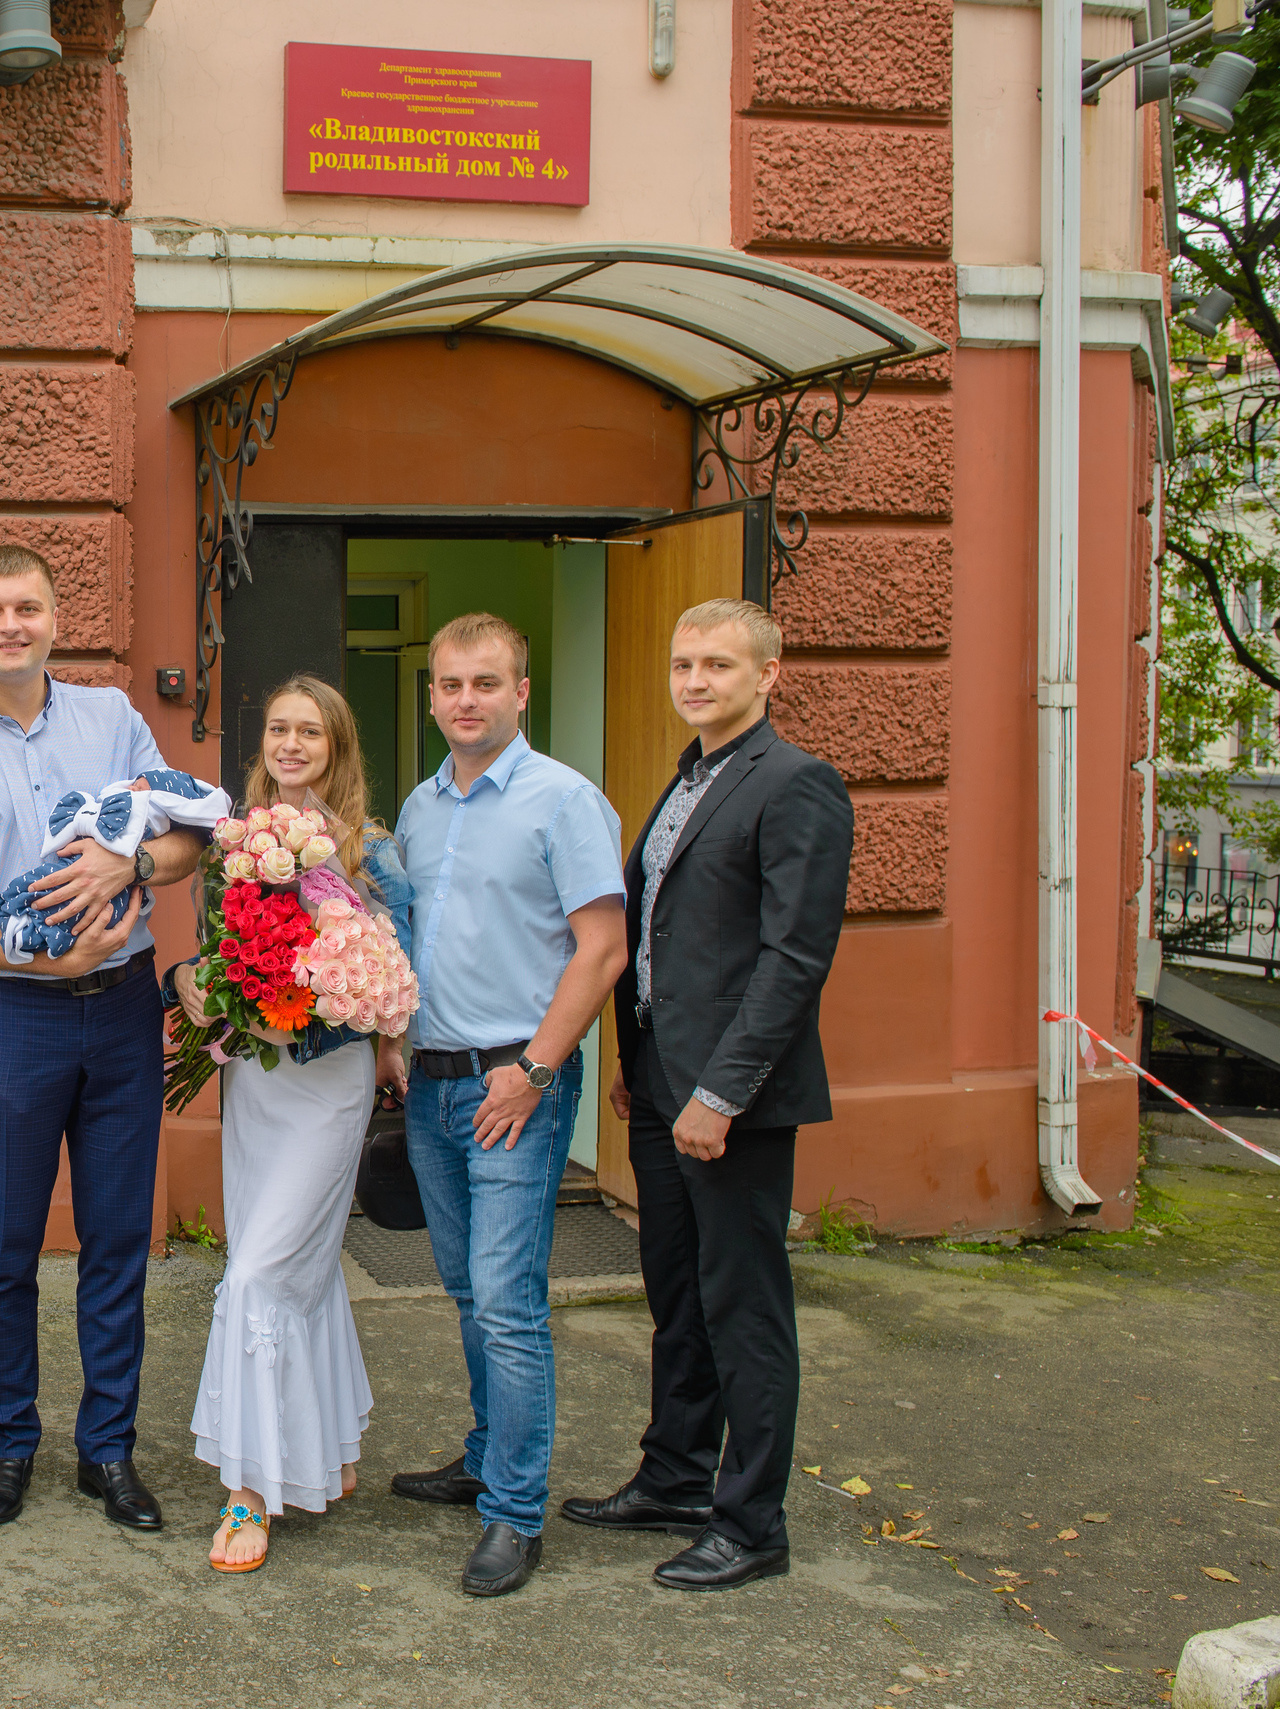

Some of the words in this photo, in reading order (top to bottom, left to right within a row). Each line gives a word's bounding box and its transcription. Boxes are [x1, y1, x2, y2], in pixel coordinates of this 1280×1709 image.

[379, 62, 432, 75] Департамент
[434, 67, 501, 78] здравоохранения
[404, 75, 458, 87] Приморского
[459, 80, 477, 89] края
[341, 88, 374, 99] Краевое
[376, 92, 443, 102] государственное
[444, 94, 489, 104] бюджетное
[490, 98, 538, 108] учреждение
[406, 105, 474, 115] здравоохранения
[309, 117, 540, 150] «Владивостокский
[309, 151, 449, 174] родильный
[456, 159, 500, 177] дом
[508, 156, 535, 178] №
[542, 158, 569, 180] 4»
